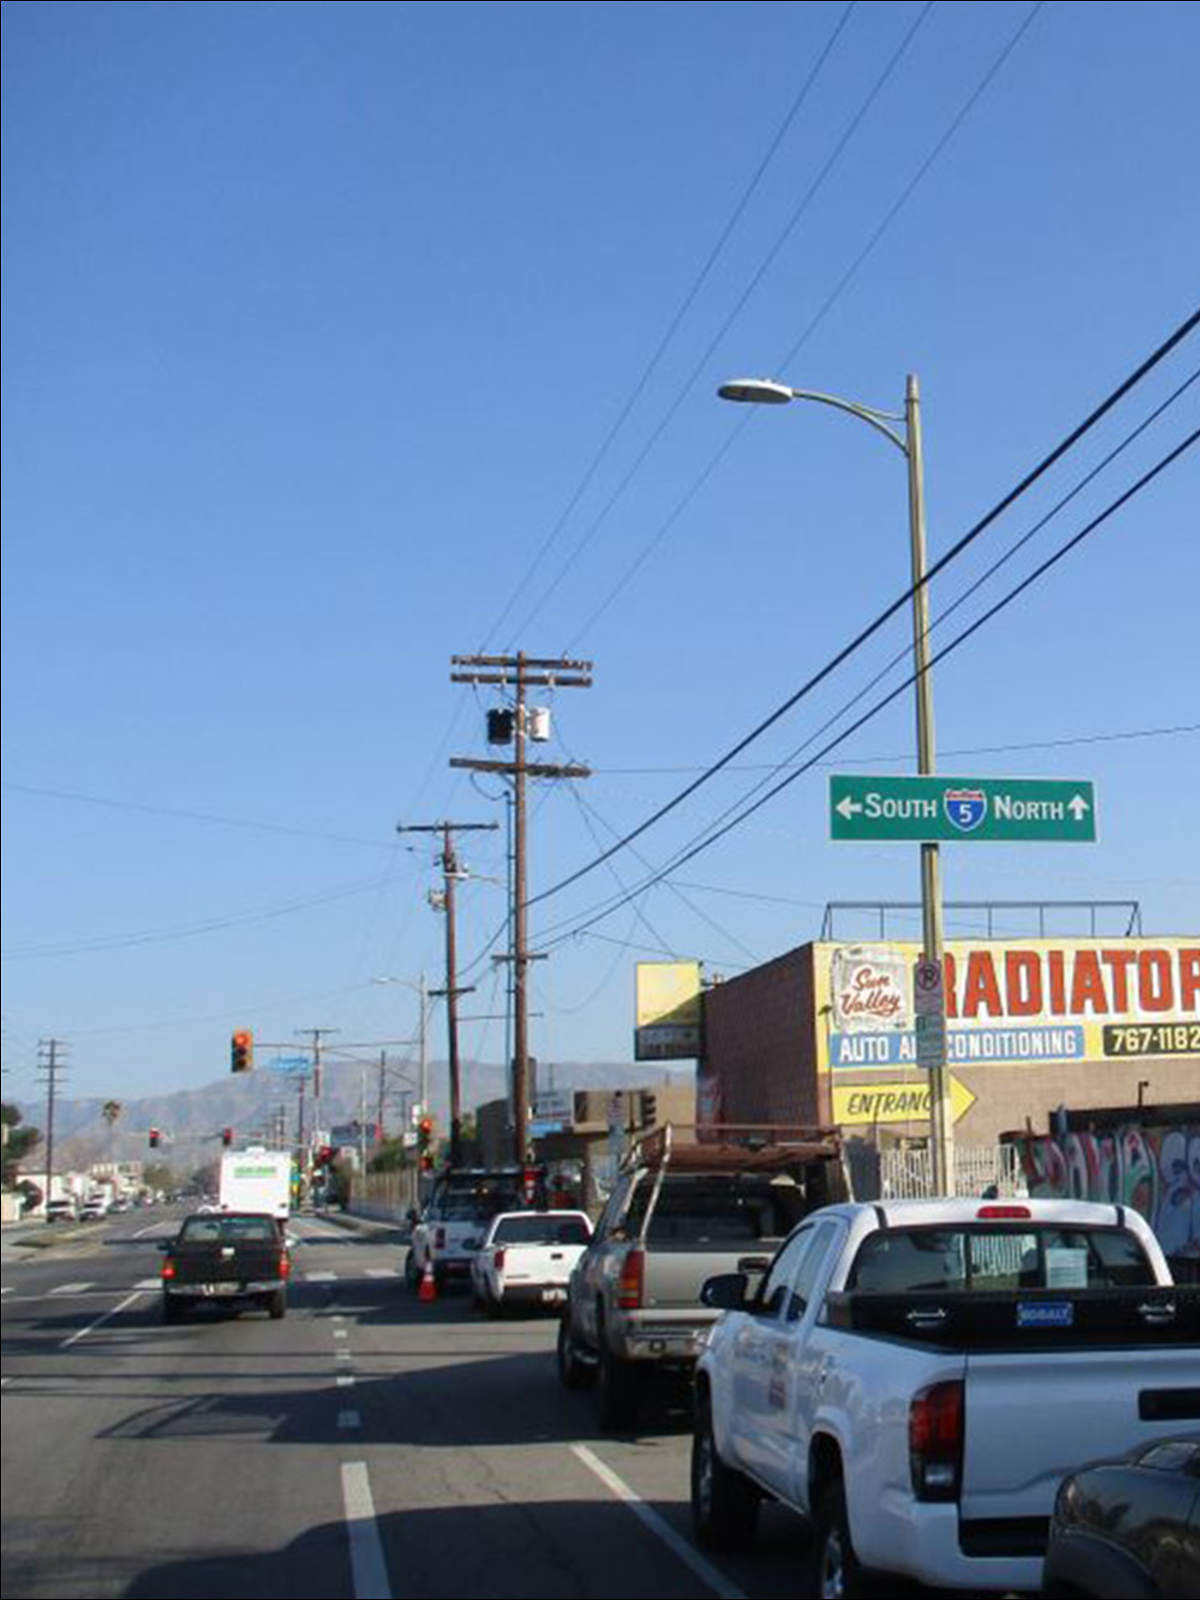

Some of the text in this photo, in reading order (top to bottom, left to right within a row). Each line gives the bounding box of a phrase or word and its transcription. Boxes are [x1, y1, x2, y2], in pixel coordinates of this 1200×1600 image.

[864, 793, 1065, 822] SOUTH 5 NORTH
[852, 967, 890, 991] Sun
[840, 988, 902, 1017] Valley
[839, 1036, 889, 1062] AUTO
[846, 1091, 935, 1116] ENTRANC
